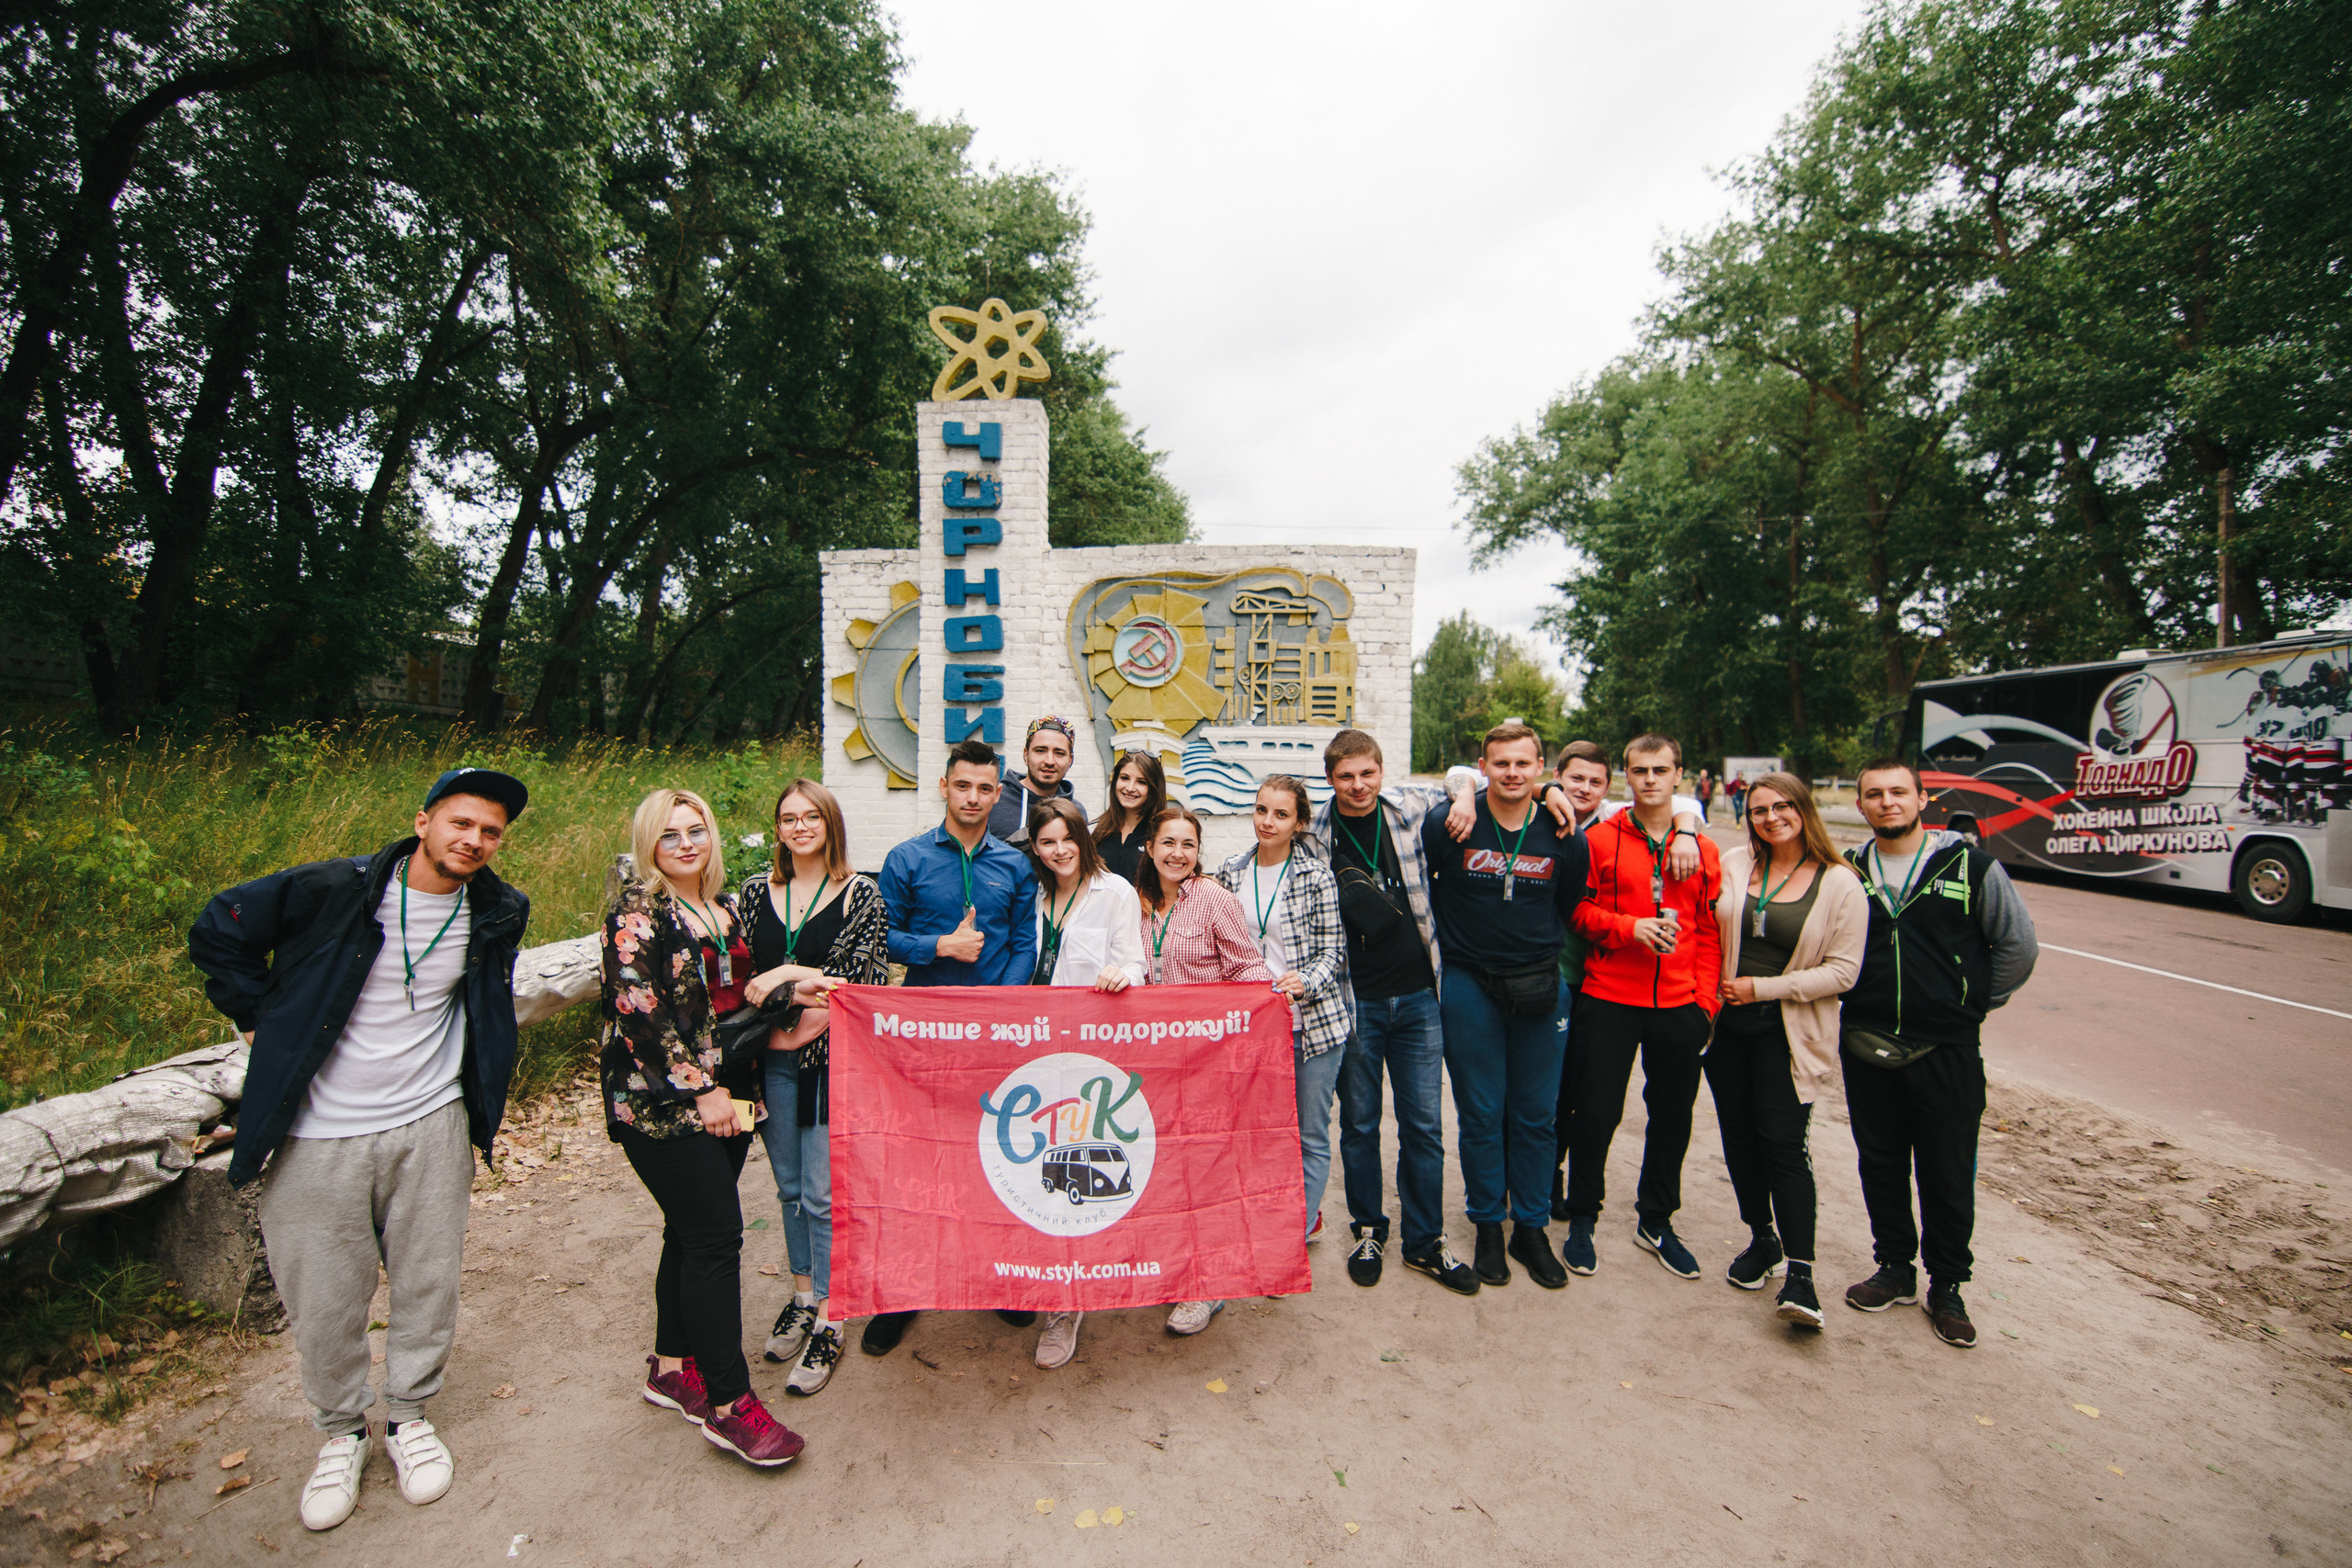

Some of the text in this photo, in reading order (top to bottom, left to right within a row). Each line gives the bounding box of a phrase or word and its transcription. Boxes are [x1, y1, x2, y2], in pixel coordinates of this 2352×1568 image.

[943, 421, 1005, 782] ЧОРНОБИ
[2052, 803, 2220, 830] ХОКЕЙНА ШКОЛА
[2045, 829, 2230, 855] ОЛЕГА ЦИРКУНОВА
[1467, 849, 1551, 876] Original
[873, 1012, 981, 1040] Менше
[990, 1016, 1051, 1047] жуй
[1080, 1010, 1251, 1044] подорожуй!
[994, 1164, 1107, 1225] туристичний клуб
[994, 1260, 1161, 1285] www.styk.com.ua
